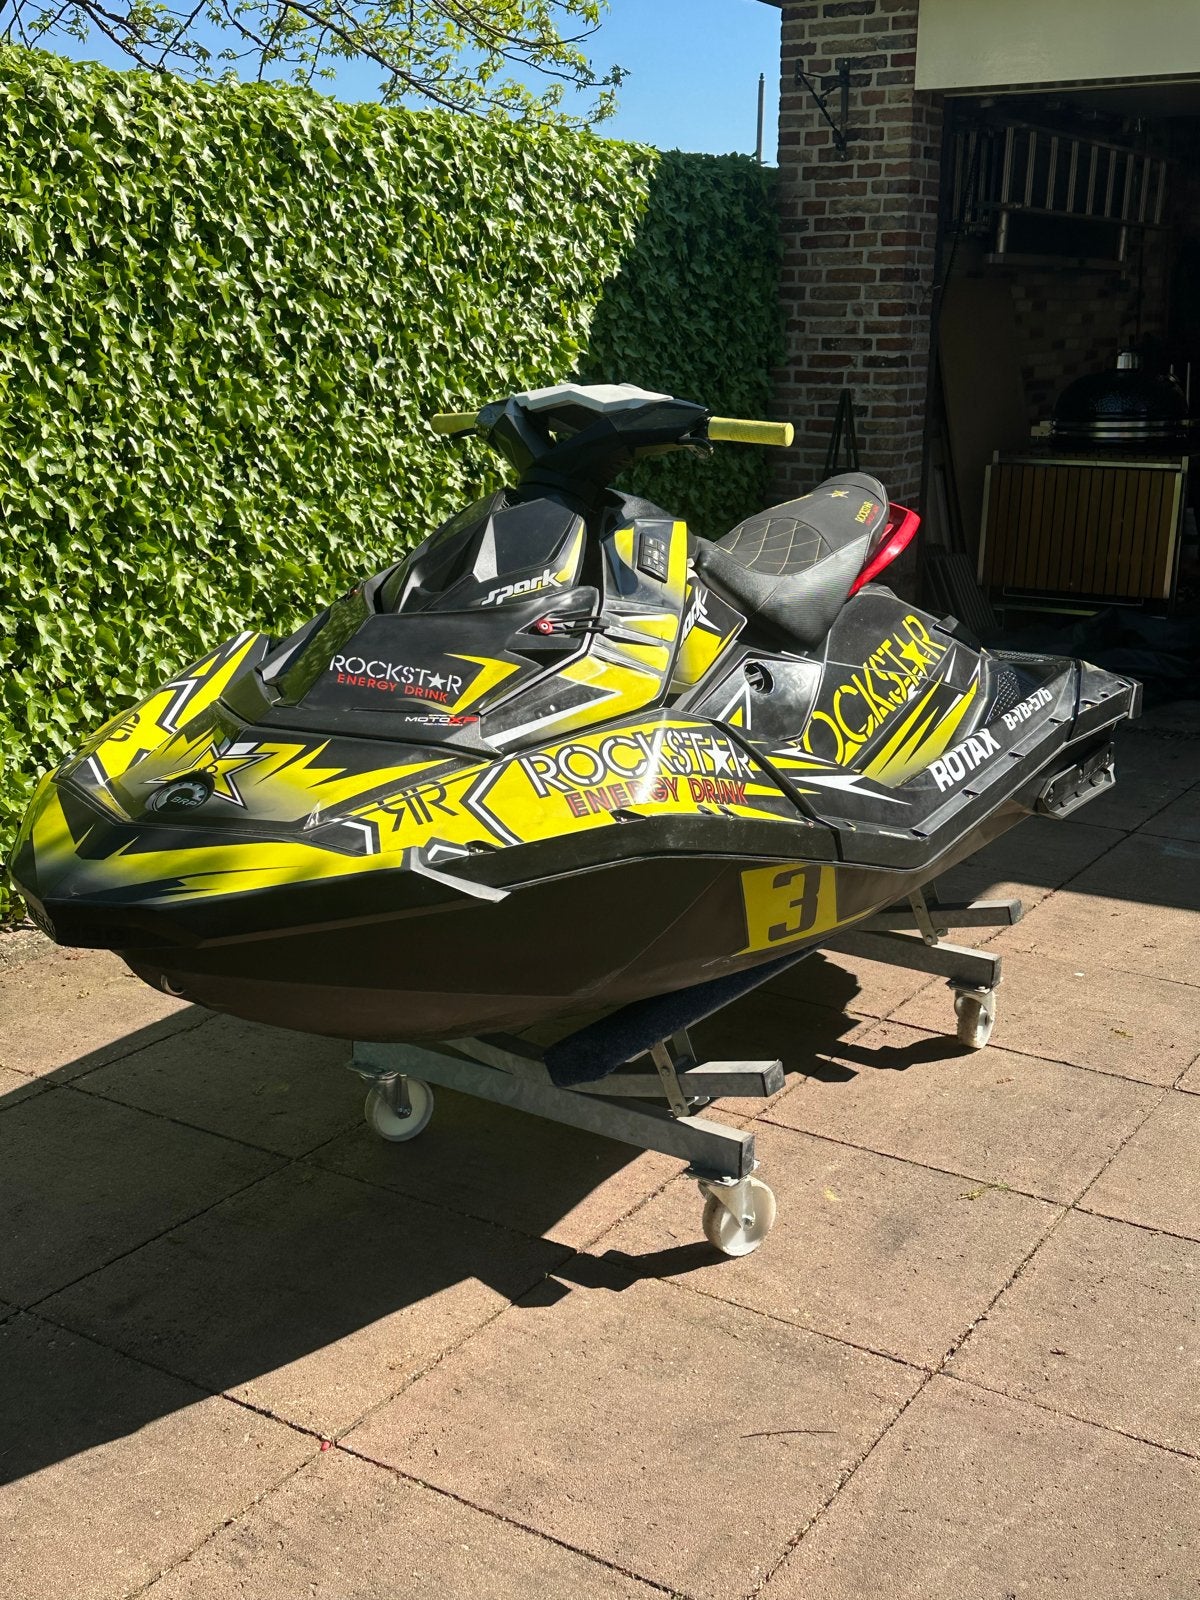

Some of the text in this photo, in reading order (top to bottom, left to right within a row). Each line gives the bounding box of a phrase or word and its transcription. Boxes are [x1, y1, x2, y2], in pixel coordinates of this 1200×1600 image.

[337, 672, 449, 704] ENERGY DRINK
[926, 728, 1002, 793] ROTAX
[170, 796, 198, 807] BRP
[564, 776, 749, 818] ENERGY DRINK
[768, 864, 822, 942] 3
